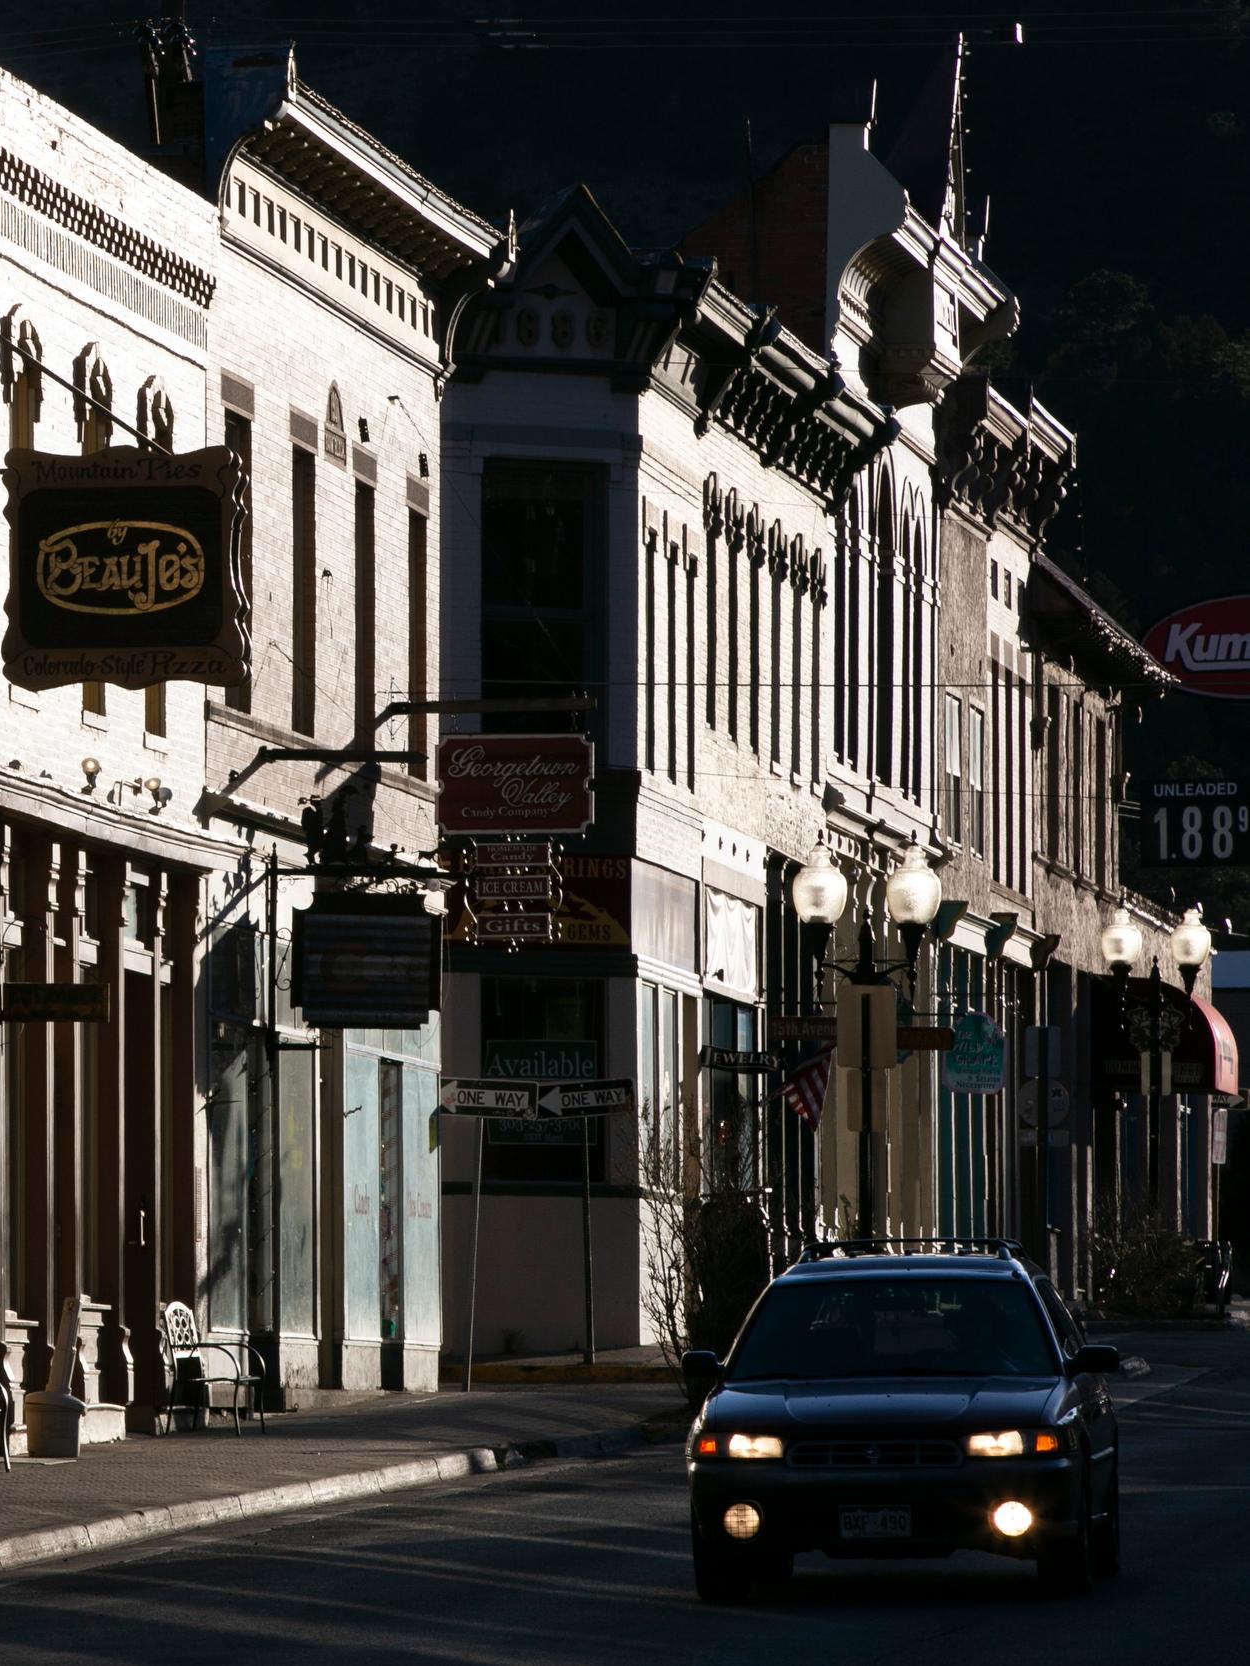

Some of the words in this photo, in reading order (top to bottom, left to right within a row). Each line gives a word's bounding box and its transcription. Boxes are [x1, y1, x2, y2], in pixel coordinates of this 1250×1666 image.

[31, 460, 138, 481] Mountain
[138, 458, 203, 481] Pies
[106, 517, 129, 545] by
[146, 651, 224, 676] Pizza
[448, 745, 581, 788] Georgetown
[501, 777, 575, 813] Valley
[1153, 782, 1238, 798] UNLEADED
[461, 807, 497, 819] Candy
[498, 806, 550, 819] Company
[490, 853, 535, 863] Candy
[482, 882, 501, 894] ICE
[503, 880, 543, 894] CREAM
[485, 919, 541, 933] Gifts
[567, 924, 611, 941] GEMS
[486, 1050, 594, 1077] Available
[704, 1046, 779, 1067] JEWELRY
[457, 1091, 485, 1105] ONE
[494, 1092, 525, 1107] WAY
[561, 1092, 590, 1106] ONE
[594, 1087, 624, 1105] WAY
